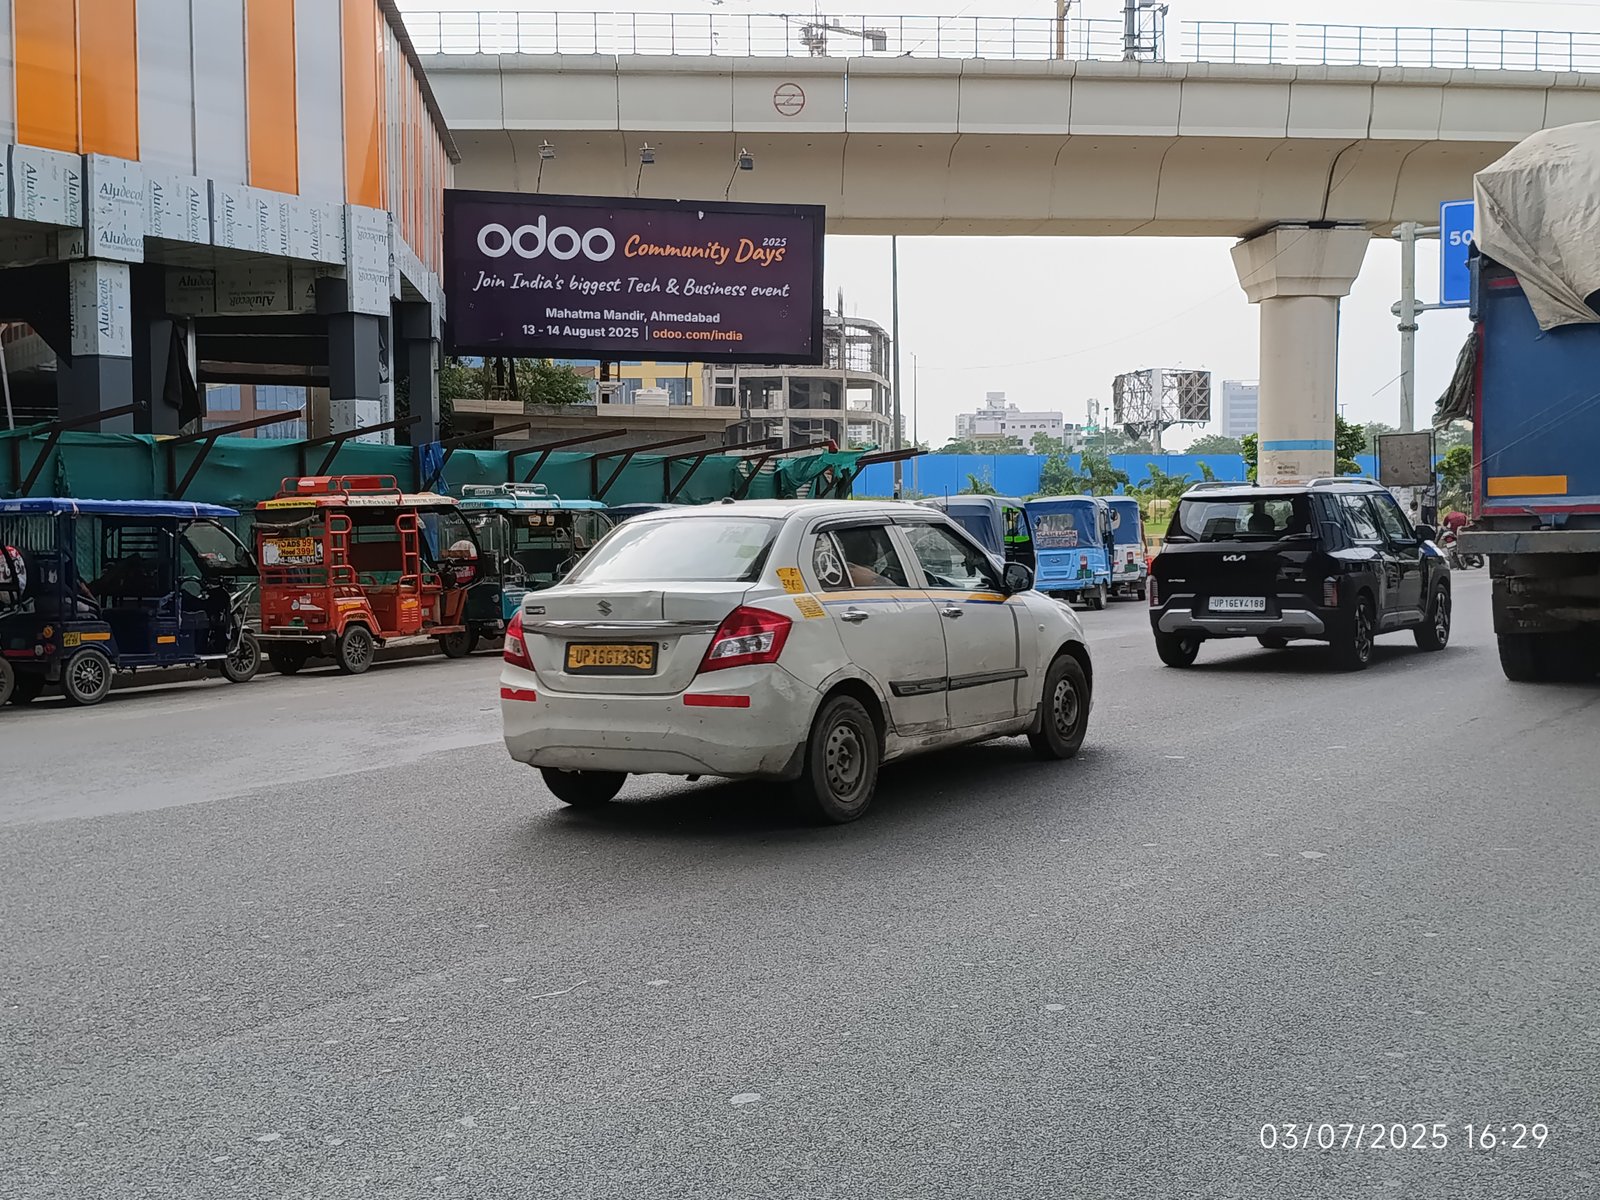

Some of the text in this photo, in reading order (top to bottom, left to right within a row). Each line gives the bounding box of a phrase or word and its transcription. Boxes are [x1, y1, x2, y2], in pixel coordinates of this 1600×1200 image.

[100, 230, 143, 248] Aludeco
[477, 215, 786, 266] odoo Community Days
[763, 237, 787, 247] 2025
[473, 271, 790, 297] Join India's biggest Tech & Business event
[98, 278, 110, 338] AludecoR
[546, 308, 720, 323] Mahatma Mandir, Ahmedabad
[522, 325, 536, 335] 13
[546, 325, 560, 336] 14
[563, 326, 606, 339] August
[608, 327, 639, 338] 2025
[653, 329, 743, 341] odoo.com/india
